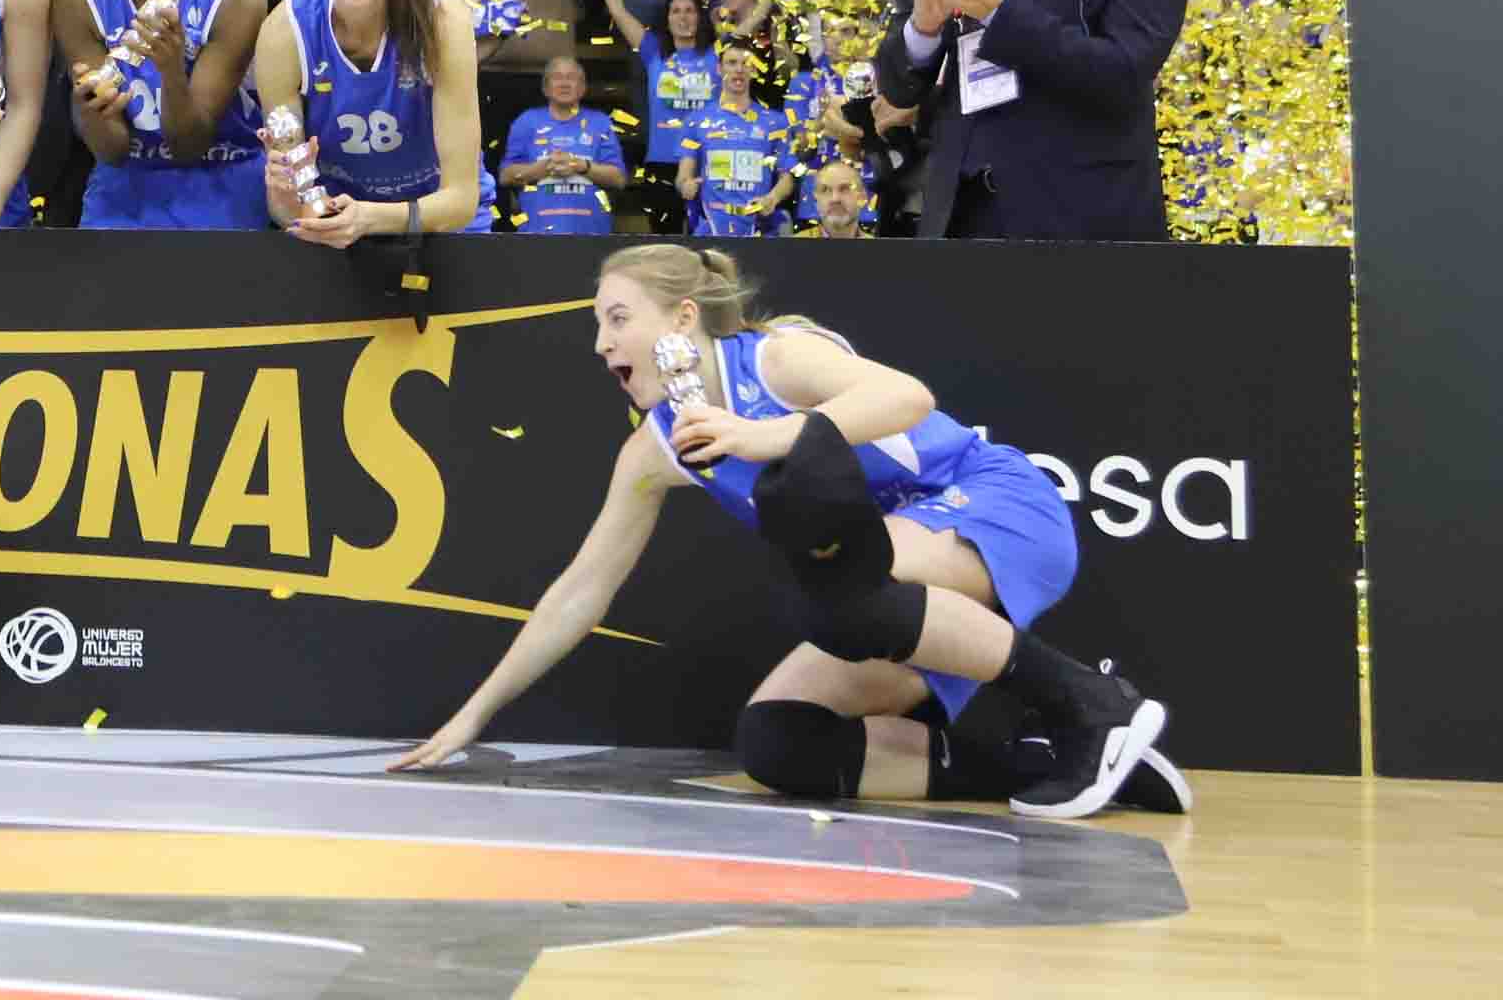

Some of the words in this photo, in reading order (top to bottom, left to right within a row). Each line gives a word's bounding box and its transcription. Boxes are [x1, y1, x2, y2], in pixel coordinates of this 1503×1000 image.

[337, 110, 403, 155] 28
[81, 628, 144, 640] UNIVERSO
[81, 640, 144, 657] MUJER
